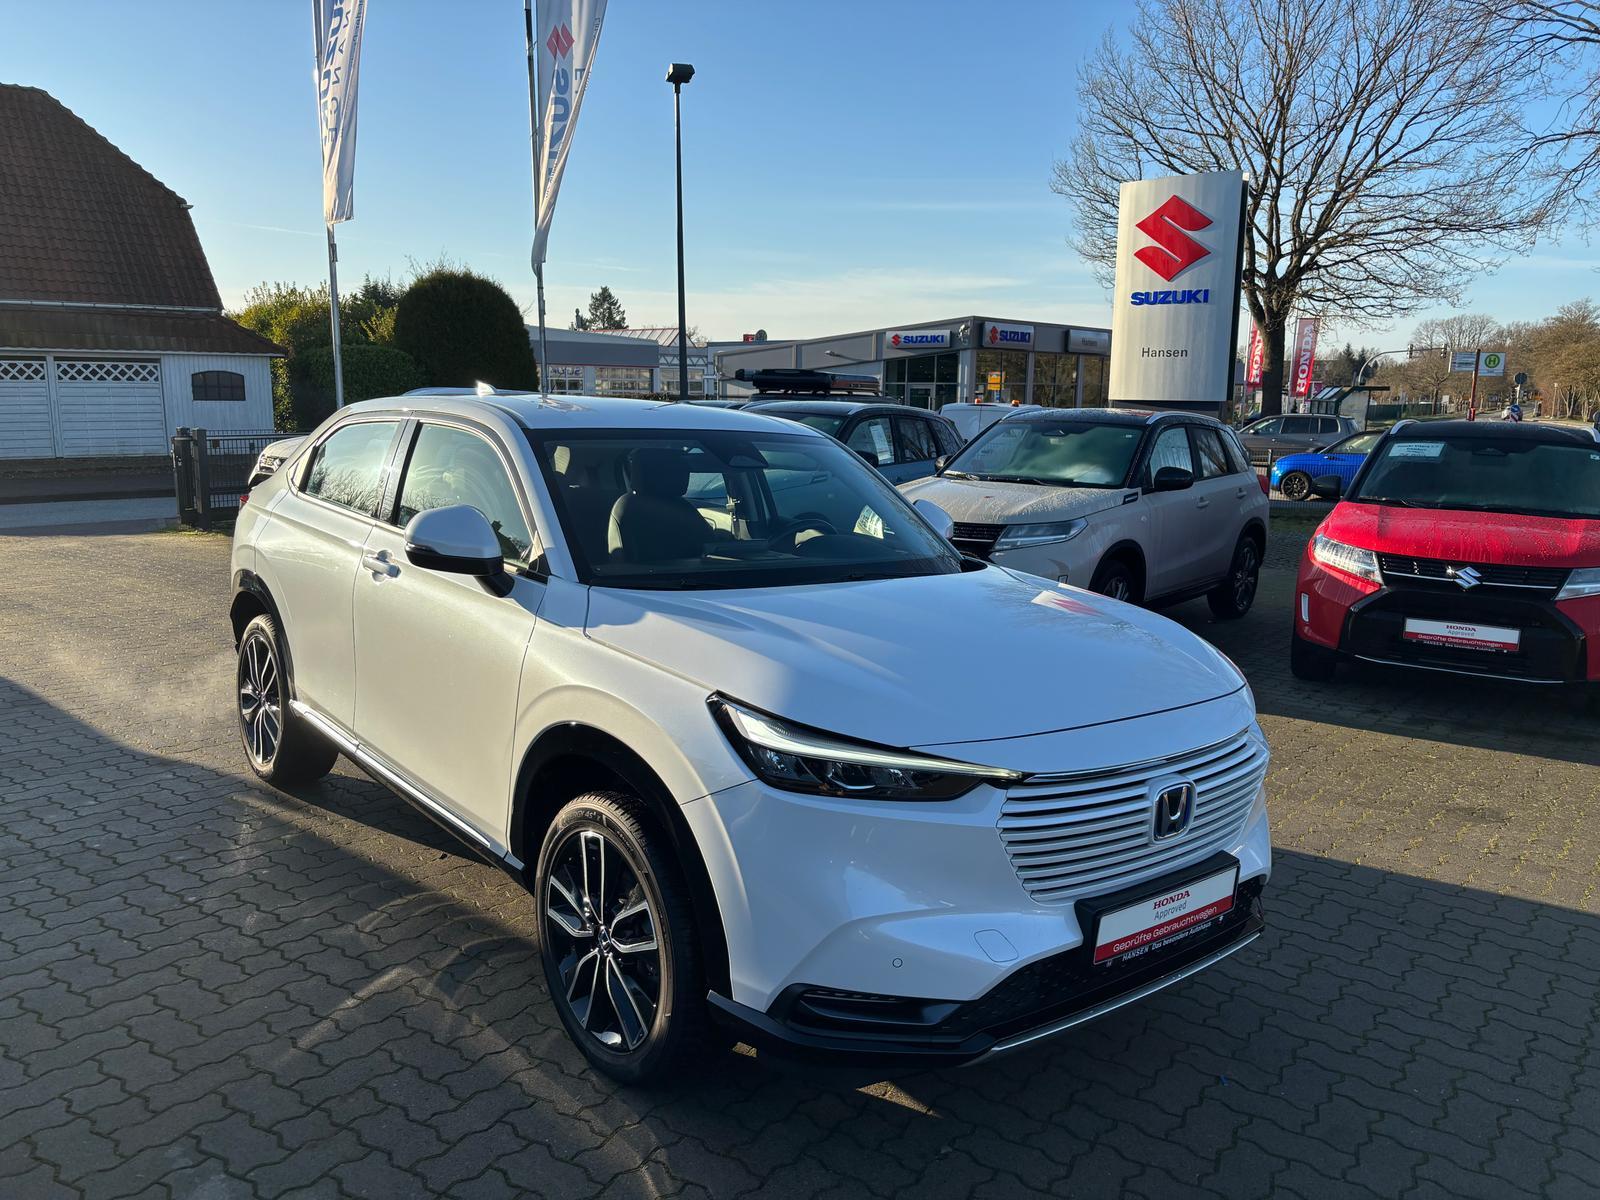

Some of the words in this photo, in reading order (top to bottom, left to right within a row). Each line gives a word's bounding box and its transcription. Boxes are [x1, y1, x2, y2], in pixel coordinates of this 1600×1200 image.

[1130, 288, 1210, 306] SUZUKI
[902, 334, 945, 344] SUZUKI
[999, 331, 1031, 343] SUZUKI
[1141, 347, 1188, 358] Hansen
[1296, 324, 1314, 393] HONDA
[1447, 637, 1504, 648] Gebrauchtwagen
[1153, 890, 1191, 910] HONDA
[1154, 900, 1187, 921] Approved
[1113, 933, 1152, 953] Geprüfte
[1152, 905, 1218, 938] Gebrauchtwagen
[1122, 946, 1149, 961] HANSEN
[1151, 940, 1162, 950] Das
